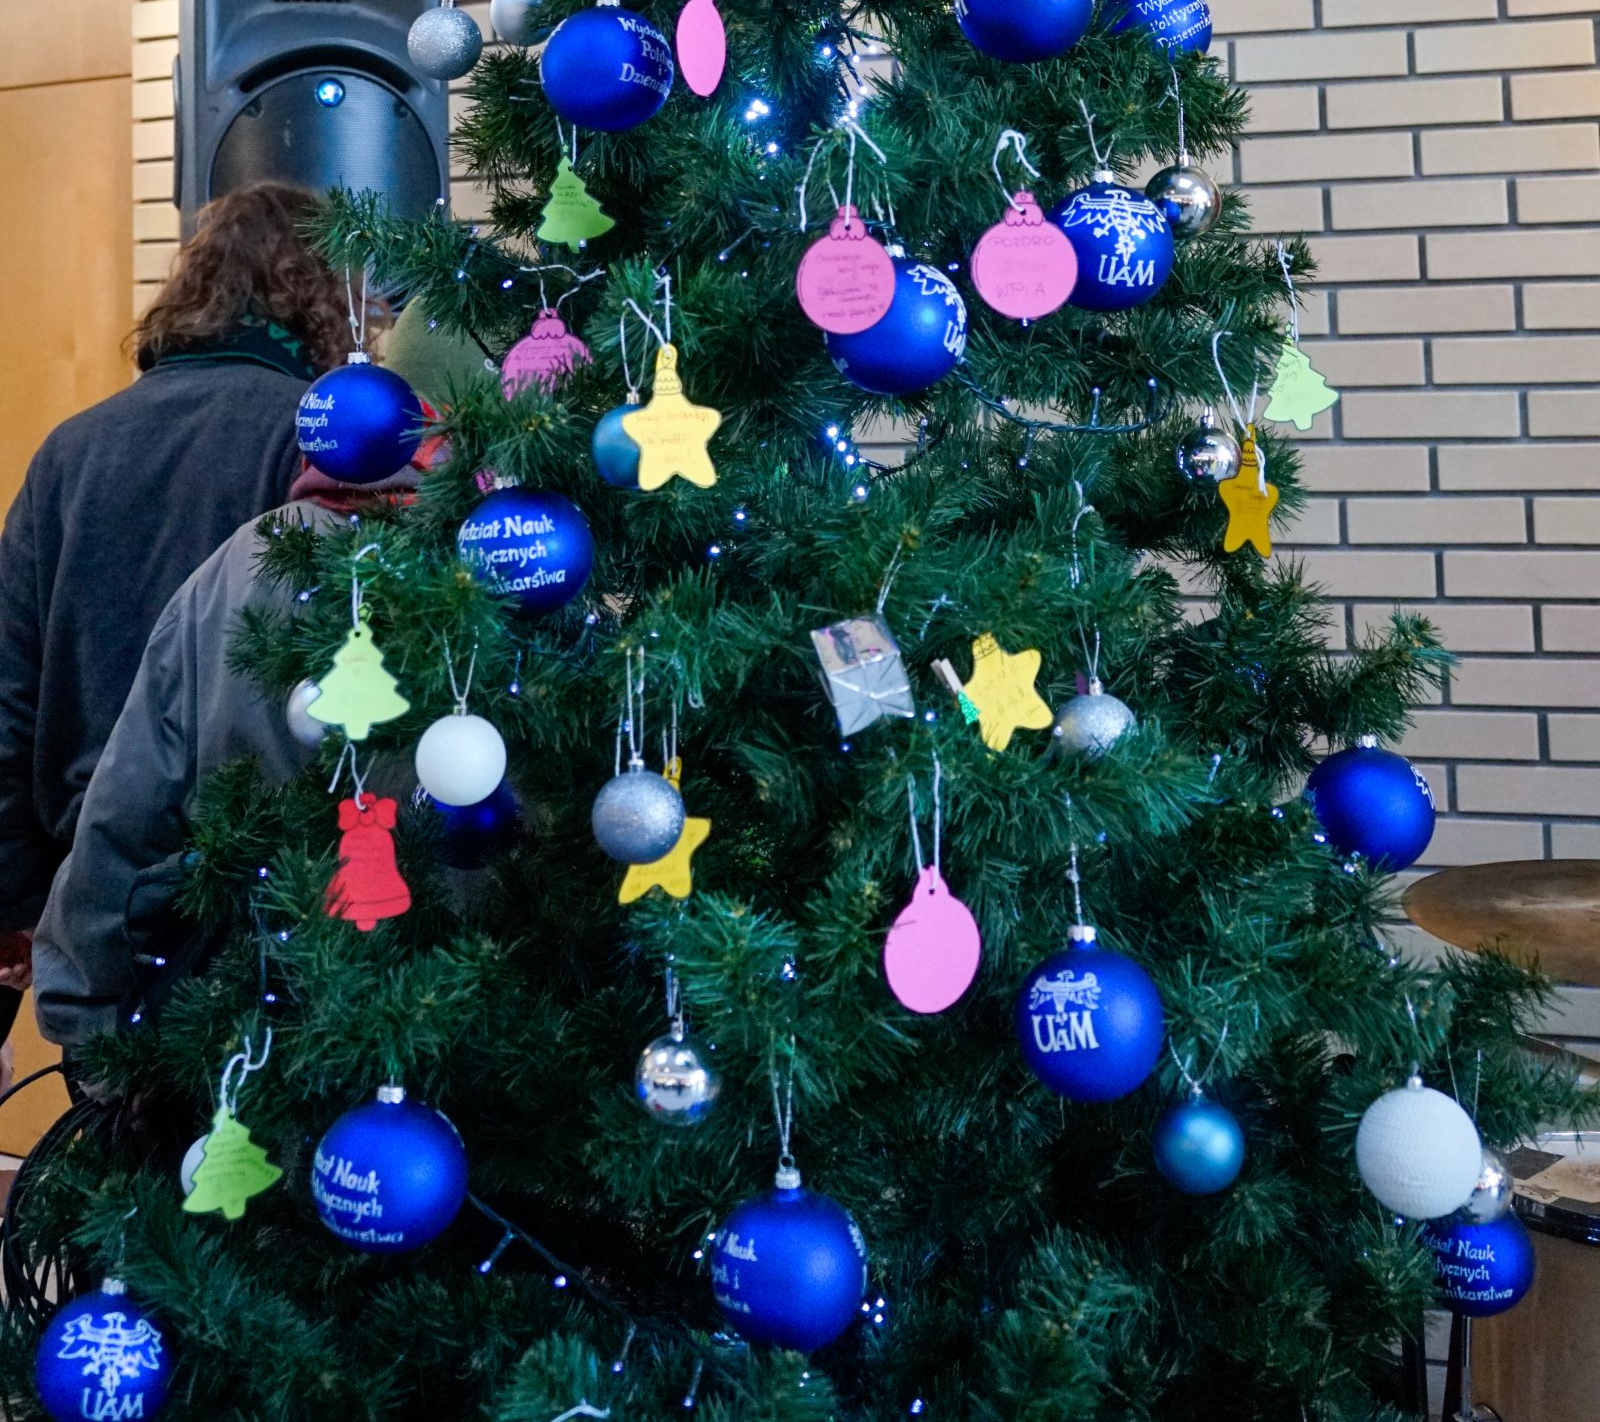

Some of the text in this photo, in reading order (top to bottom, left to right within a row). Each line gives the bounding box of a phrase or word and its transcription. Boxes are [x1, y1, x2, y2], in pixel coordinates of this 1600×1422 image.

[1098, 254, 1155, 288] UAM
[503, 514, 555, 539] Nauk
[1031, 1010, 1100, 1053] UAM
[331, 1157, 381, 1195] Nauk
[1456, 1240, 1496, 1262] Nauk
[82, 1387, 144, 1421] UAM
